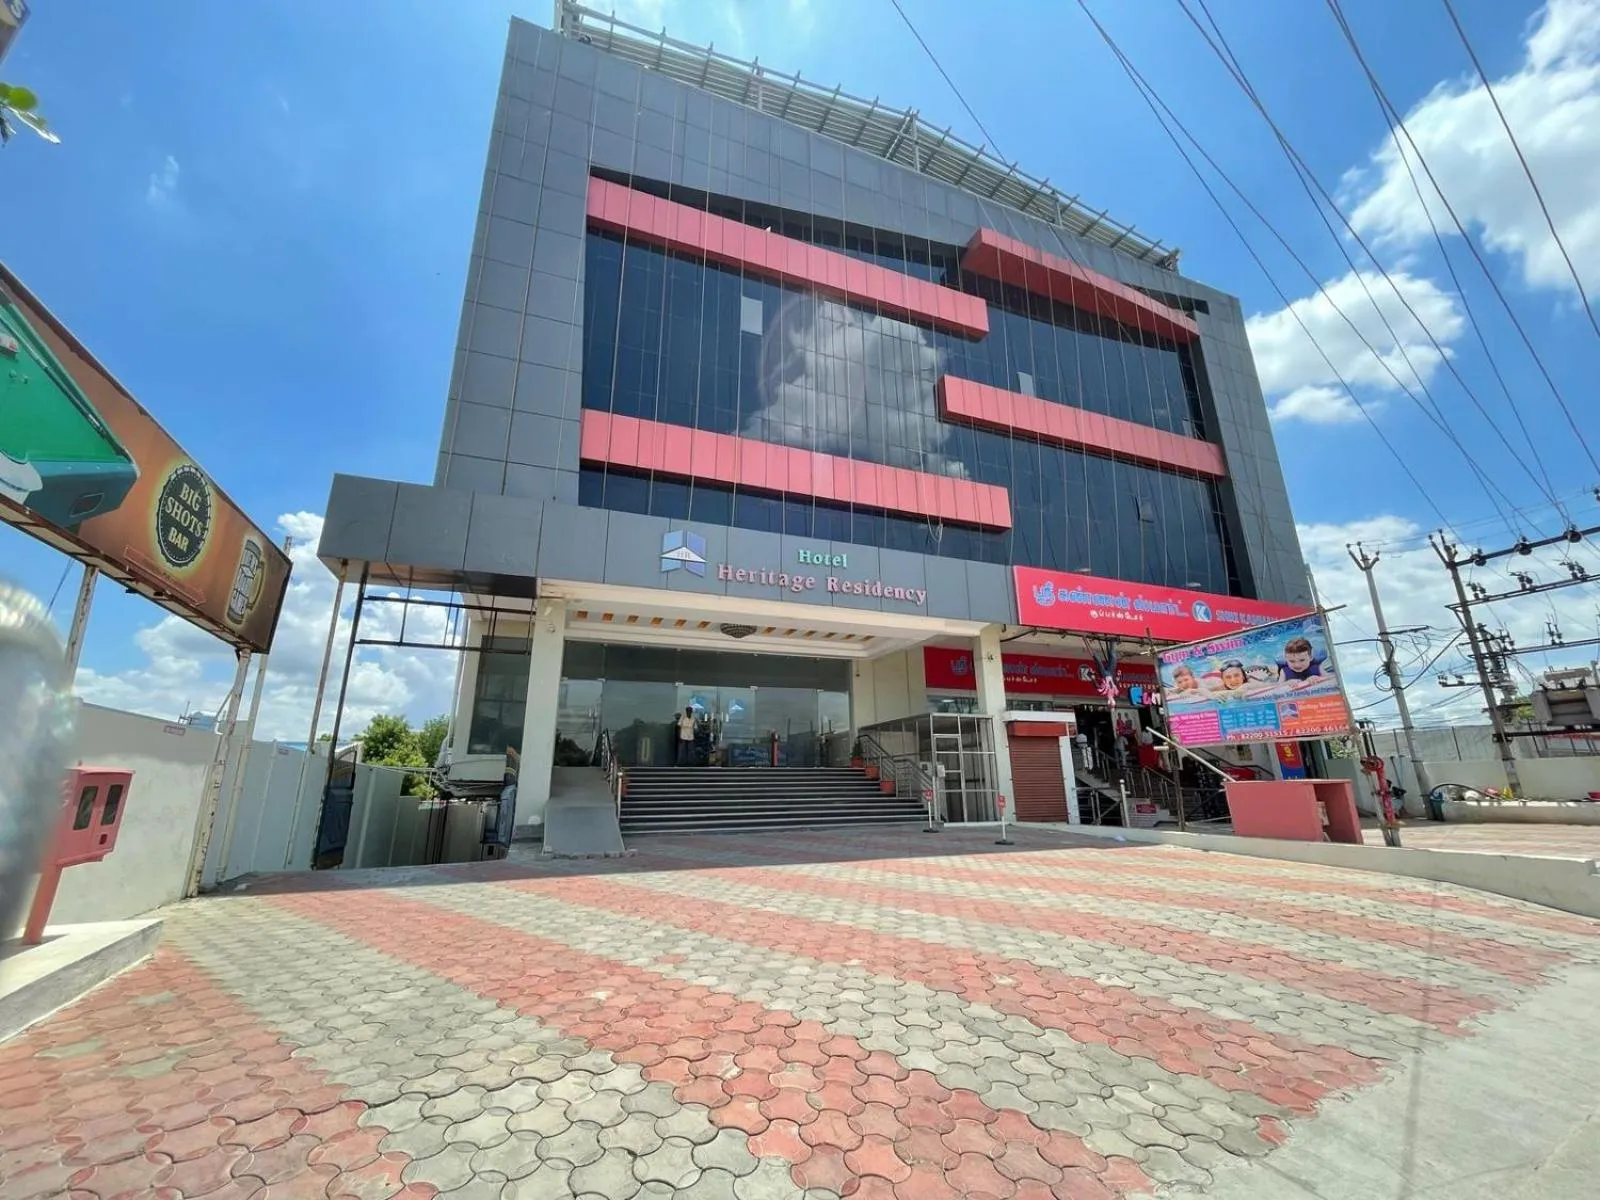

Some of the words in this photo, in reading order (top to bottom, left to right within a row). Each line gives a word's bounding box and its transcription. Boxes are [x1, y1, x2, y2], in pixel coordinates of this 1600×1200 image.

[180, 483, 202, 511] BIG
[165, 497, 203, 537] SHOTS
[168, 527, 190, 552] BAR
[798, 549, 847, 568] Hotel
[718, 563, 815, 593] Heritage
[827, 576, 927, 606] Residency
[1163, 648, 1189, 664] Gym
[1192, 645, 1203, 657] &
[1207, 637, 1244, 654] Swim
